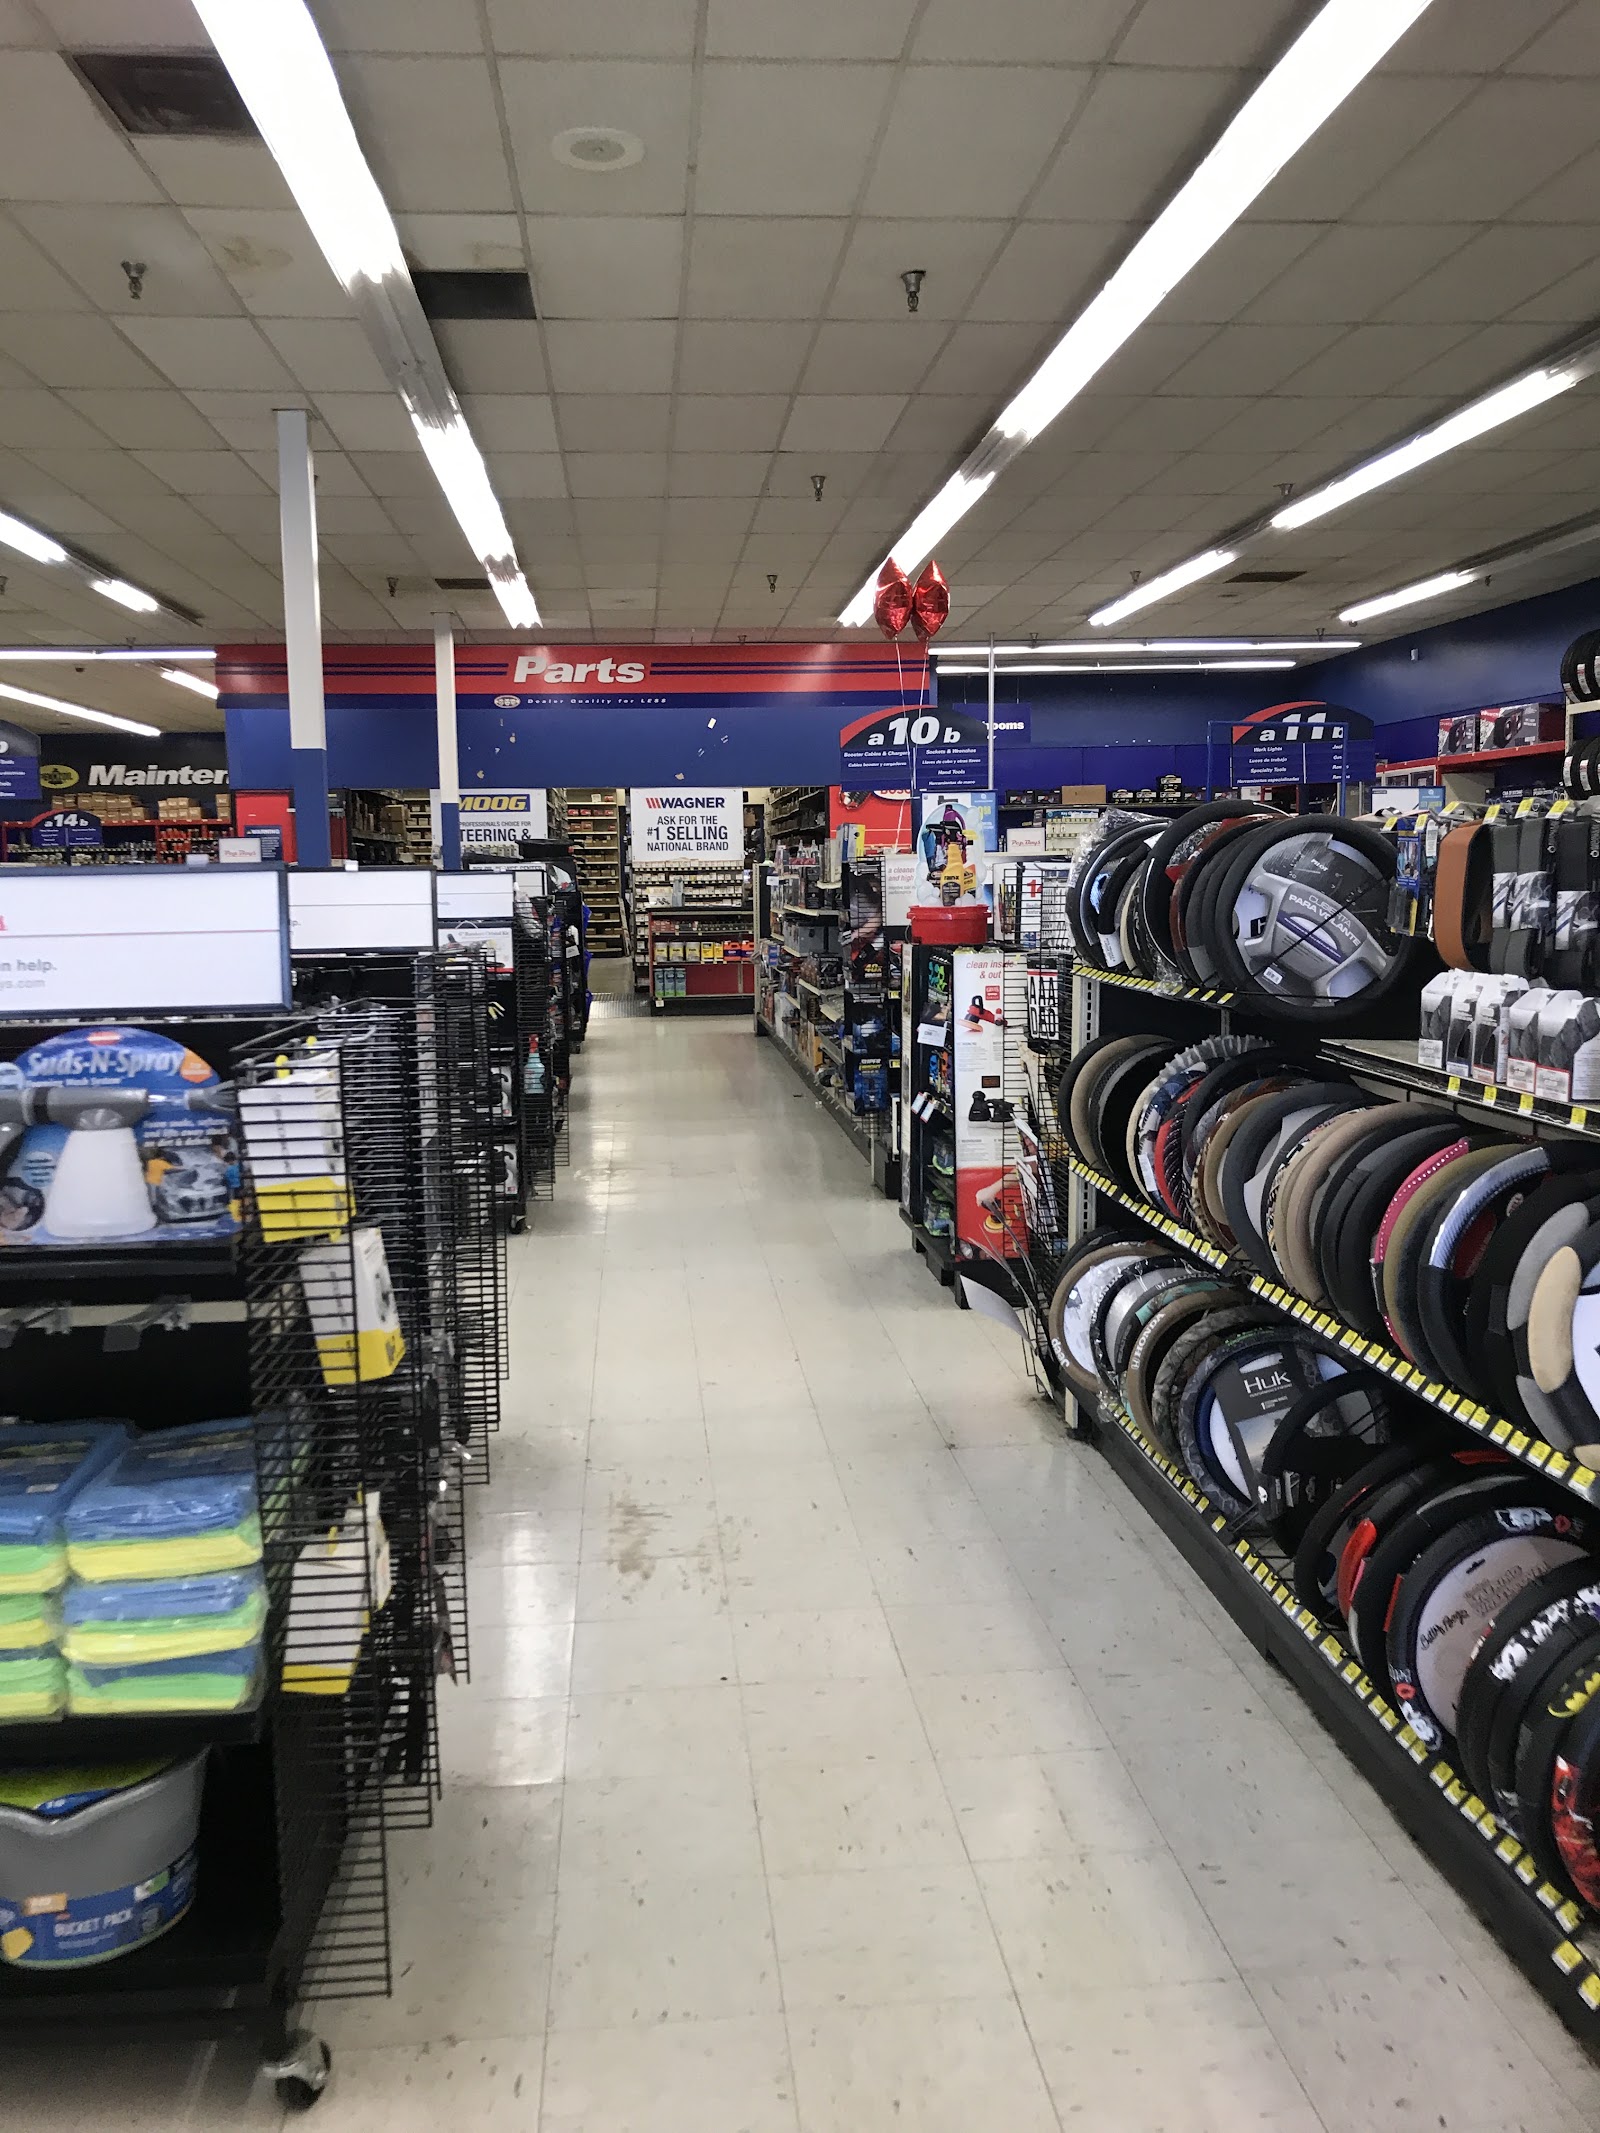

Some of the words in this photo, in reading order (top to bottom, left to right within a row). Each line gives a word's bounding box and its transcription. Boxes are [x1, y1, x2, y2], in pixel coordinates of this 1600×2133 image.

[513, 656, 645, 684] Parts
[459, 796, 527, 811] MOOG
[660, 797, 726, 810] WAGNER
[657, 816, 676, 826] ASK
[678, 815, 698, 825] FOR
[699, 815, 718, 825] THE
[647, 827, 664, 841] #1
[666, 826, 729, 841] SELLING
[646, 842, 694, 852] NATIONAL
[696, 841, 729, 852] BRAND
[1025, 839, 1041, 847] Boys
[1310, 858, 1329, 872] PILOT
[1289, 893, 1318, 914] PARA
[17, 958, 58, 974] help.
[966, 960, 988, 969] clean
[990, 959, 1015, 968] inside
[979, 971, 986, 979] &
[988, 970, 1002, 979] out
[27, 1049, 183, 1078] Suds-N-Spray
[1135, 1312, 1167, 1353] HONDA
[1243, 1371, 1292, 1394] Huk
